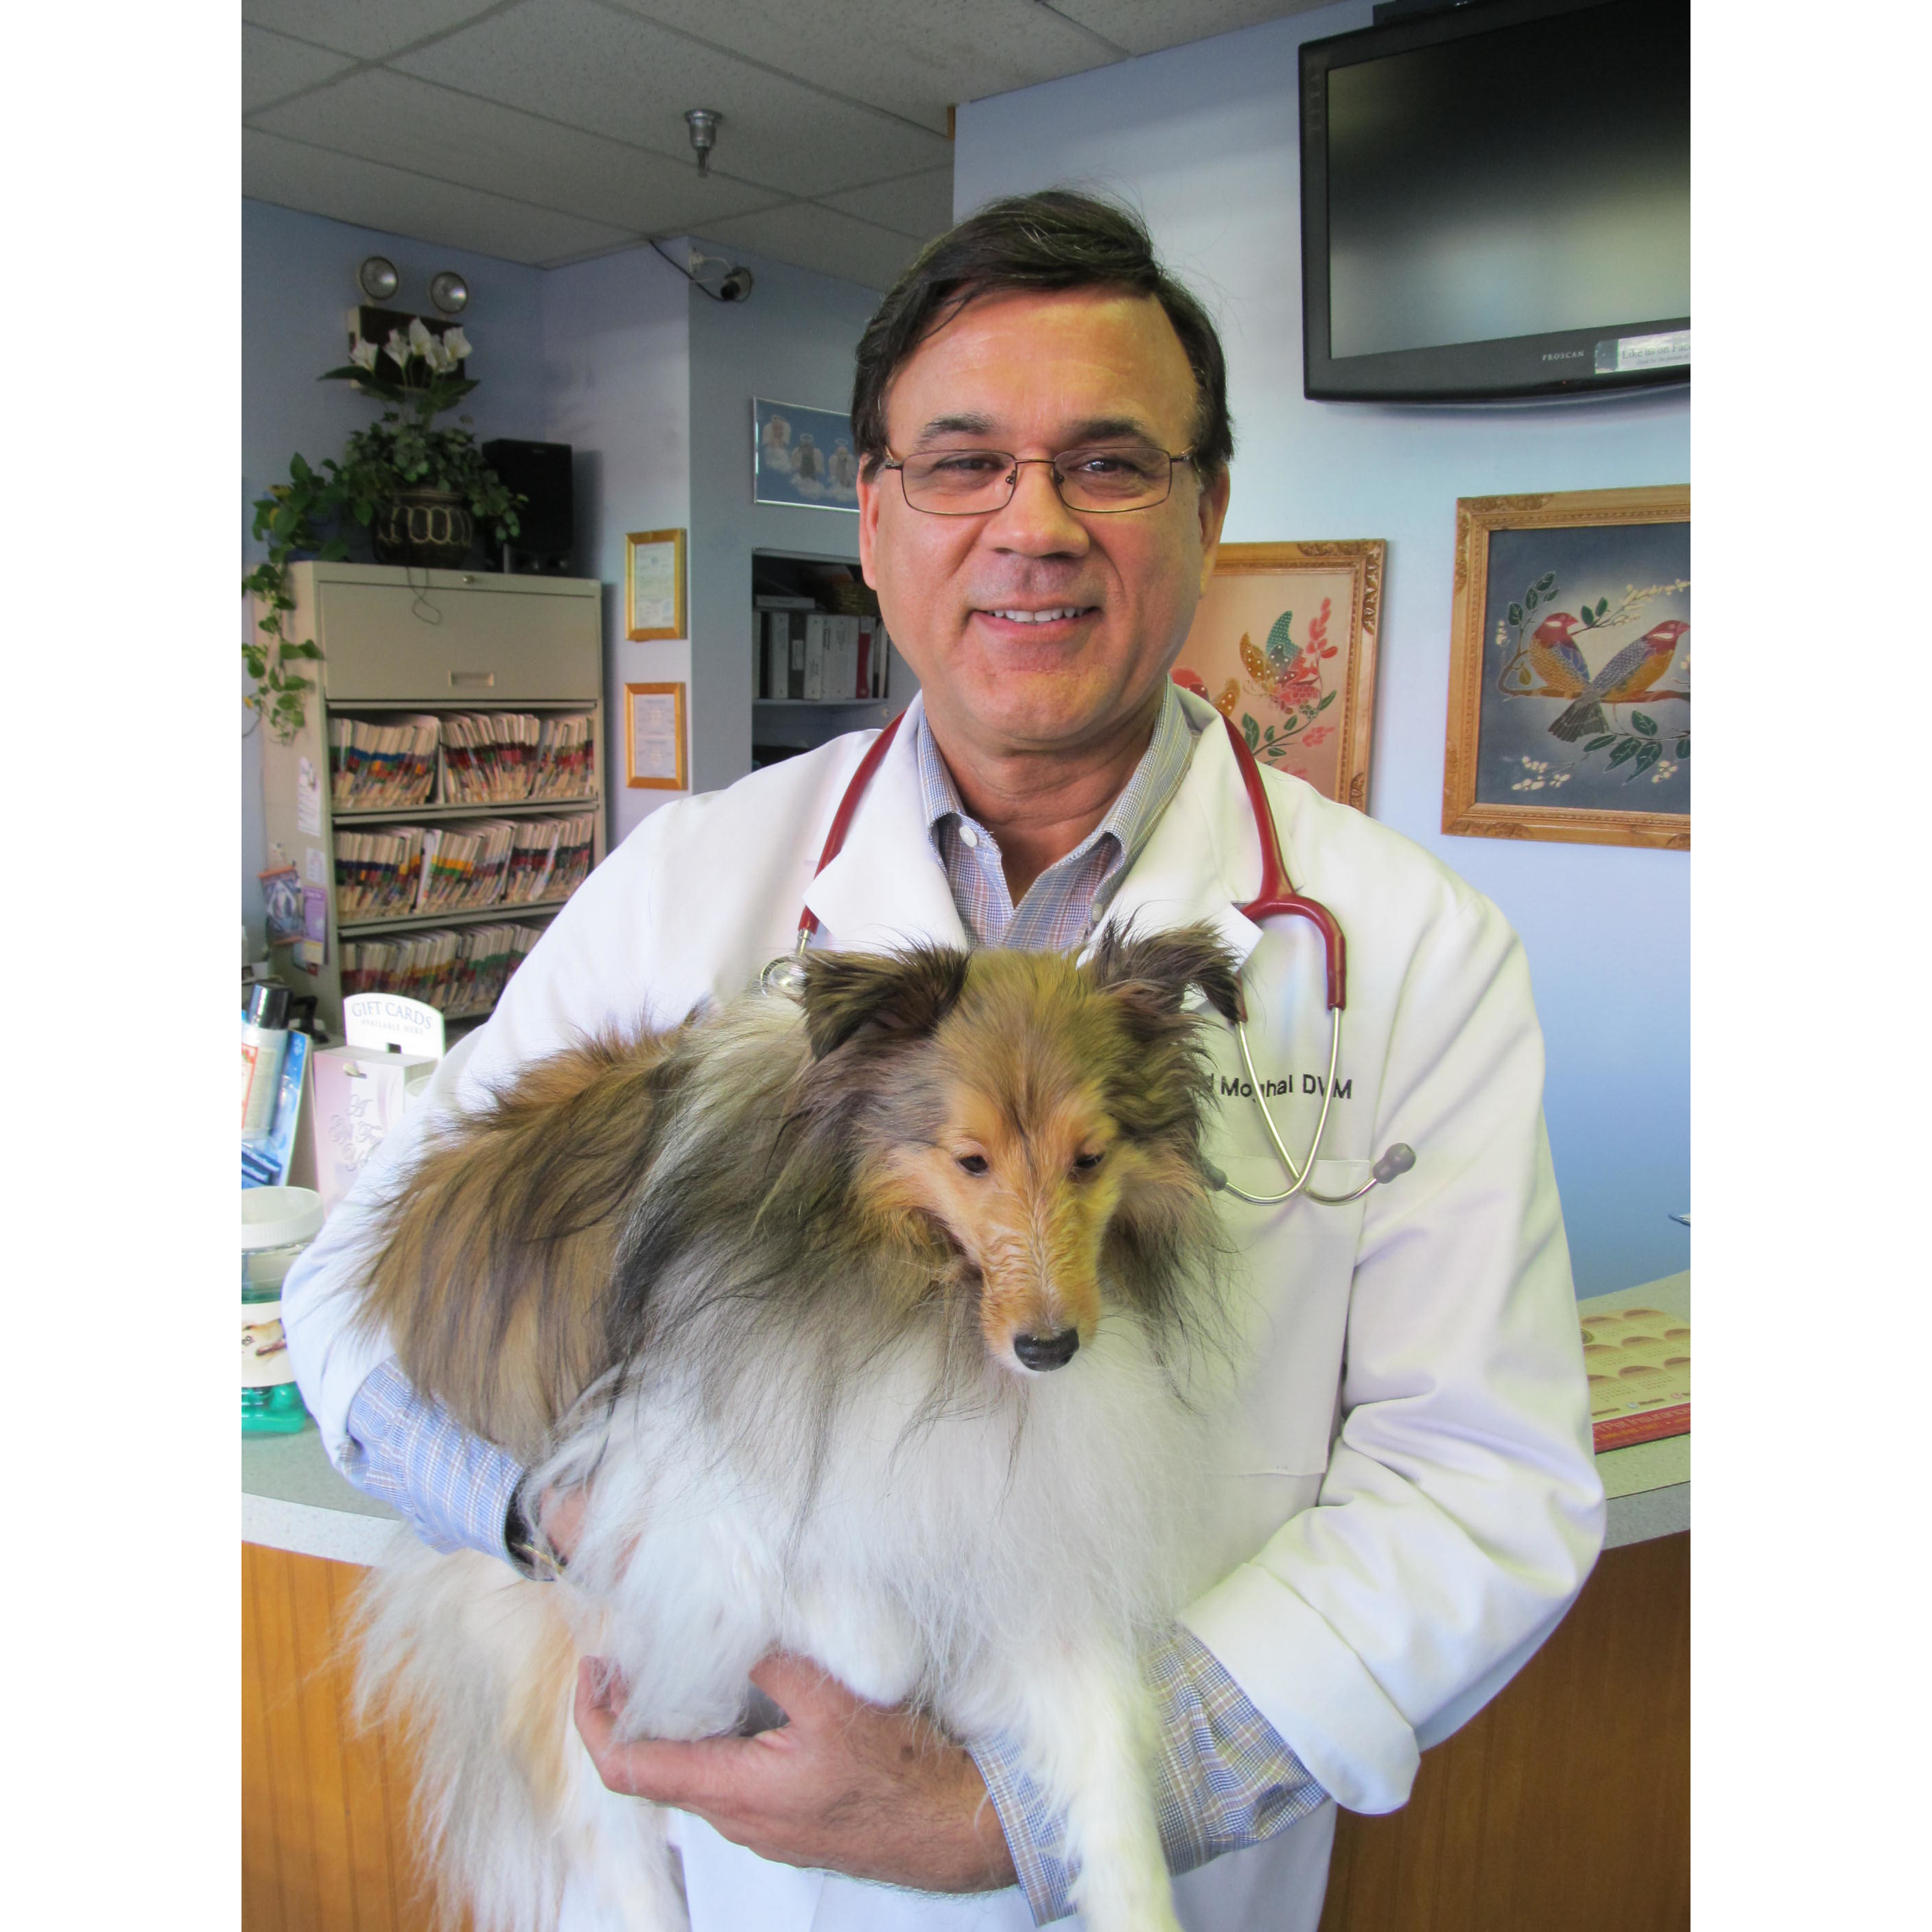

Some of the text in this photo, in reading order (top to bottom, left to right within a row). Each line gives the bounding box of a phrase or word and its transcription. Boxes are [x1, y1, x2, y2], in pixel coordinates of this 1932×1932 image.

[1542, 351, 1584, 361] PROSCAN
[1622, 349, 1642, 360] Like
[1657, 346, 1669, 355] on
[352, 1001, 432, 1030] GIFT CARDS
